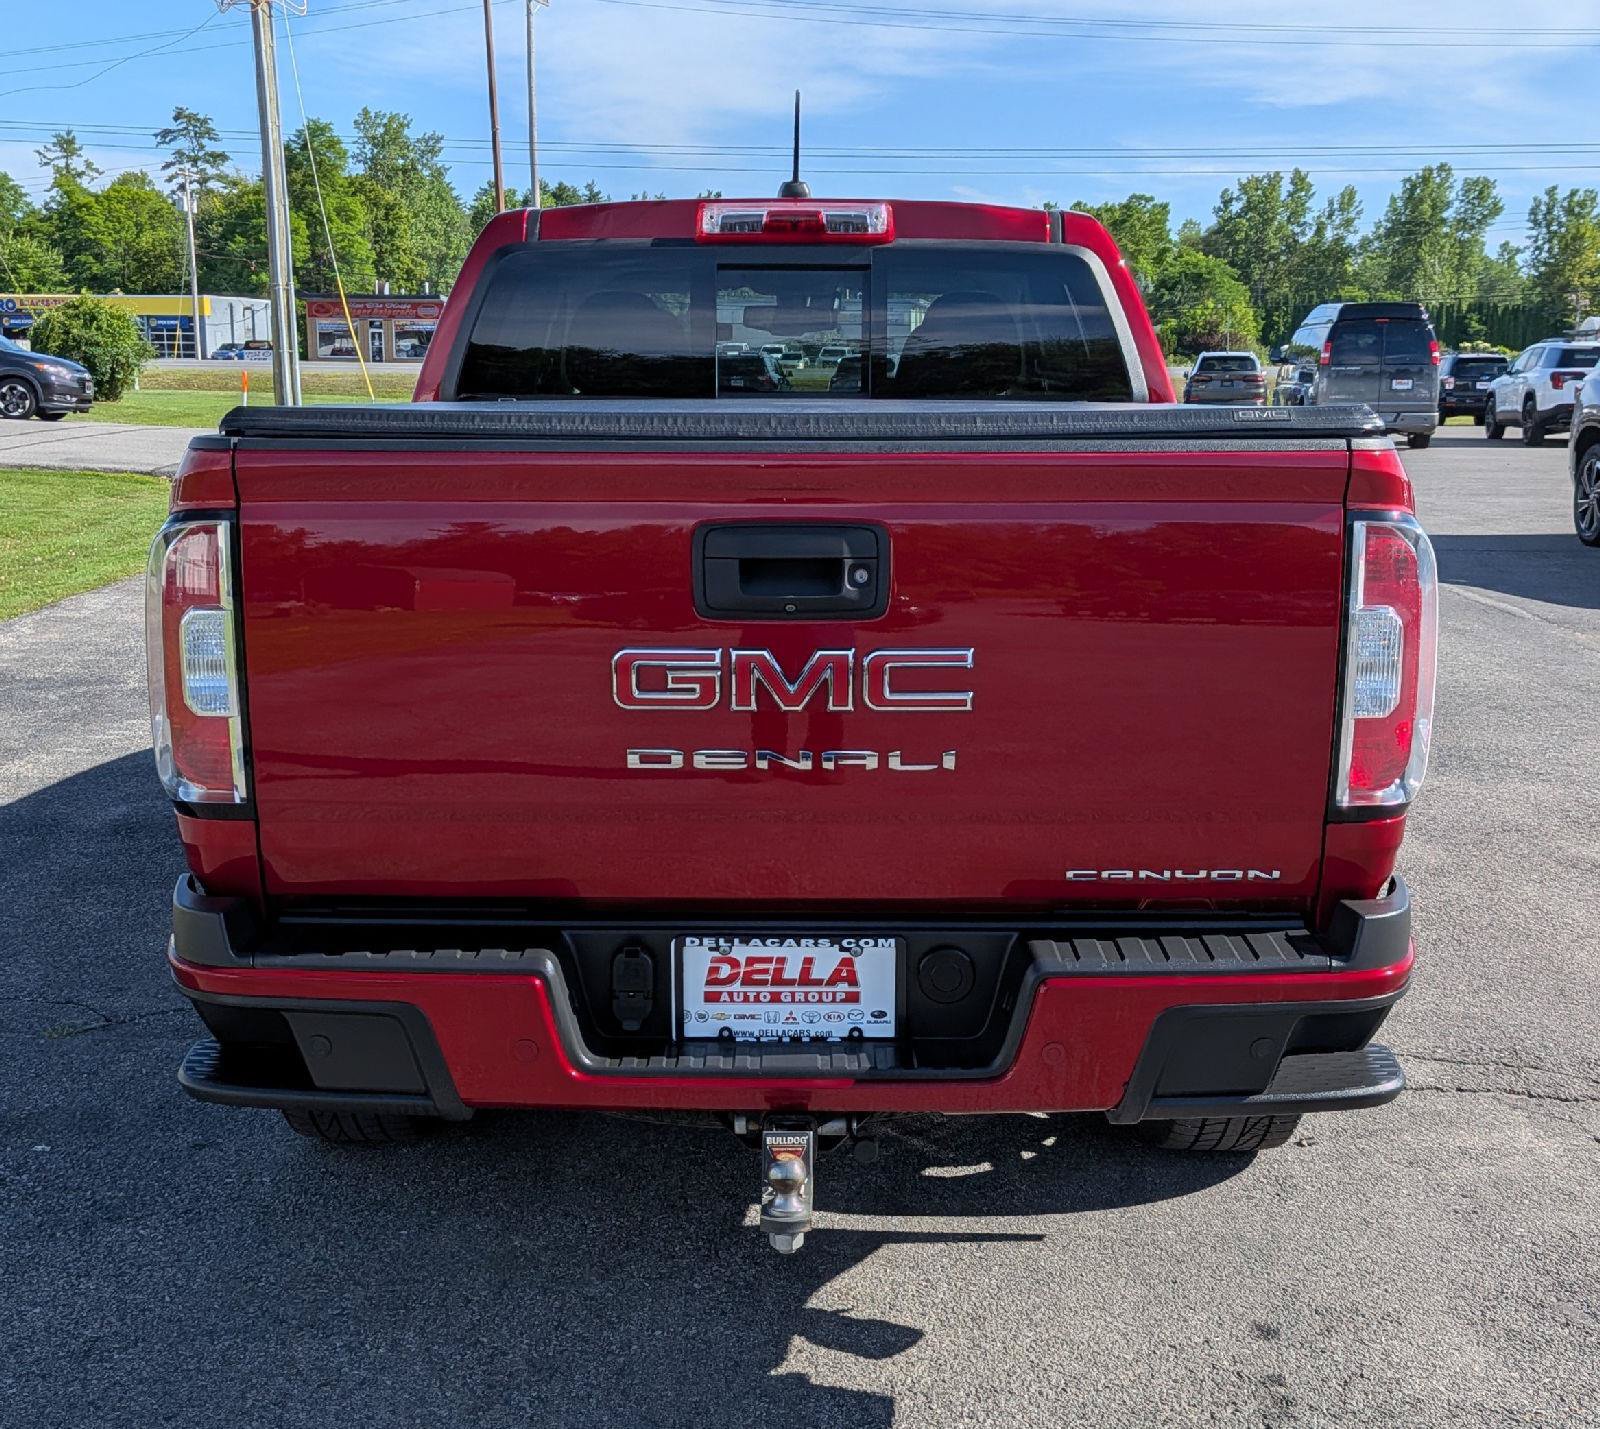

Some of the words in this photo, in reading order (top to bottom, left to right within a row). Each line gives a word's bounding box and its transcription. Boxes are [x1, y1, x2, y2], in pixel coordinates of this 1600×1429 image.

[1239, 410, 1288, 418] GMC
[611, 648, 975, 712] GMC
[626, 749, 956, 770] DENALI
[1065, 870, 1281, 881] CANYON
[684, 937, 896, 948] DELLACARS.COM
[704, 955, 860, 988] DELLA
[719, 990, 771, 1003] AUTO
[780, 990, 846, 1003] GROUP
[733, 1028, 833, 1038] www.DELLACARS.com
[766, 1136, 807, 1145] BULLDOG
